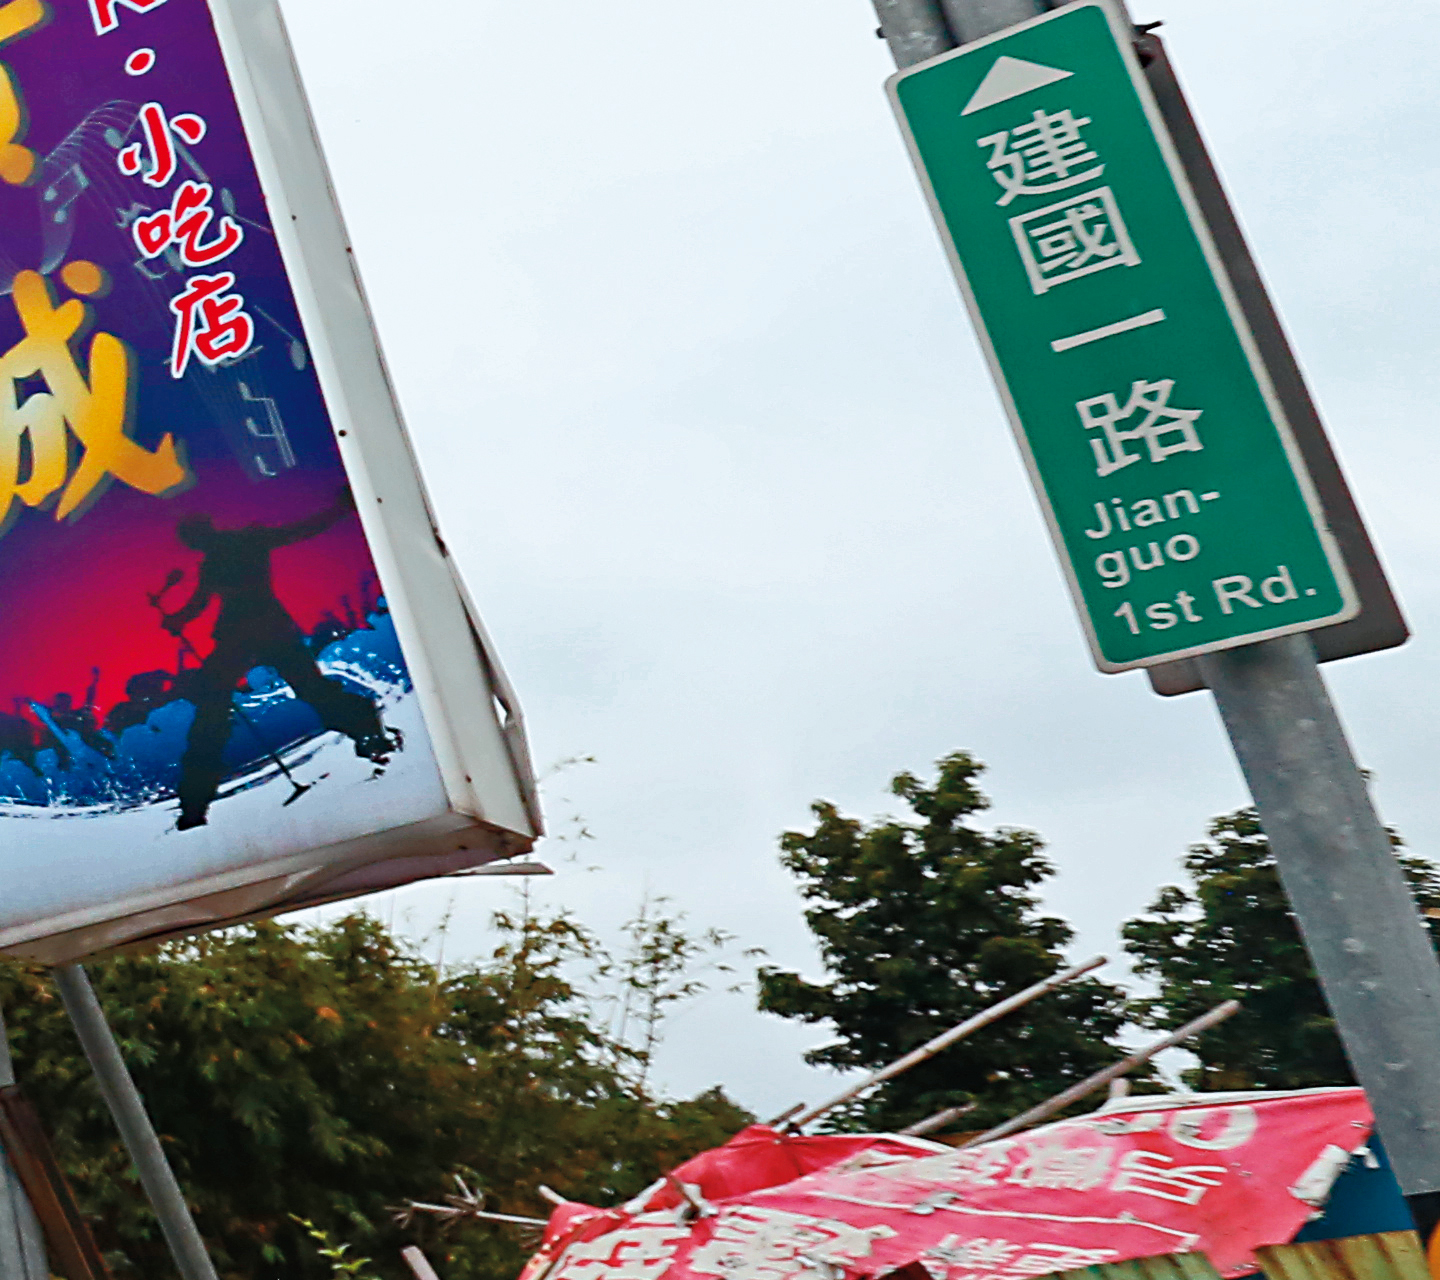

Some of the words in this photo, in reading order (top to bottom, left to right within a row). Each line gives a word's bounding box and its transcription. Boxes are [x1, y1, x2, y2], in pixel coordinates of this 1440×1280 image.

[976, 108, 1205, 478] 建國一路
[1084, 485, 1221, 540] Jian-
[1094, 532, 1200, 589] guo
[1113, 588, 1203, 636] 1st
[1212, 566, 1317, 615] Rd.
